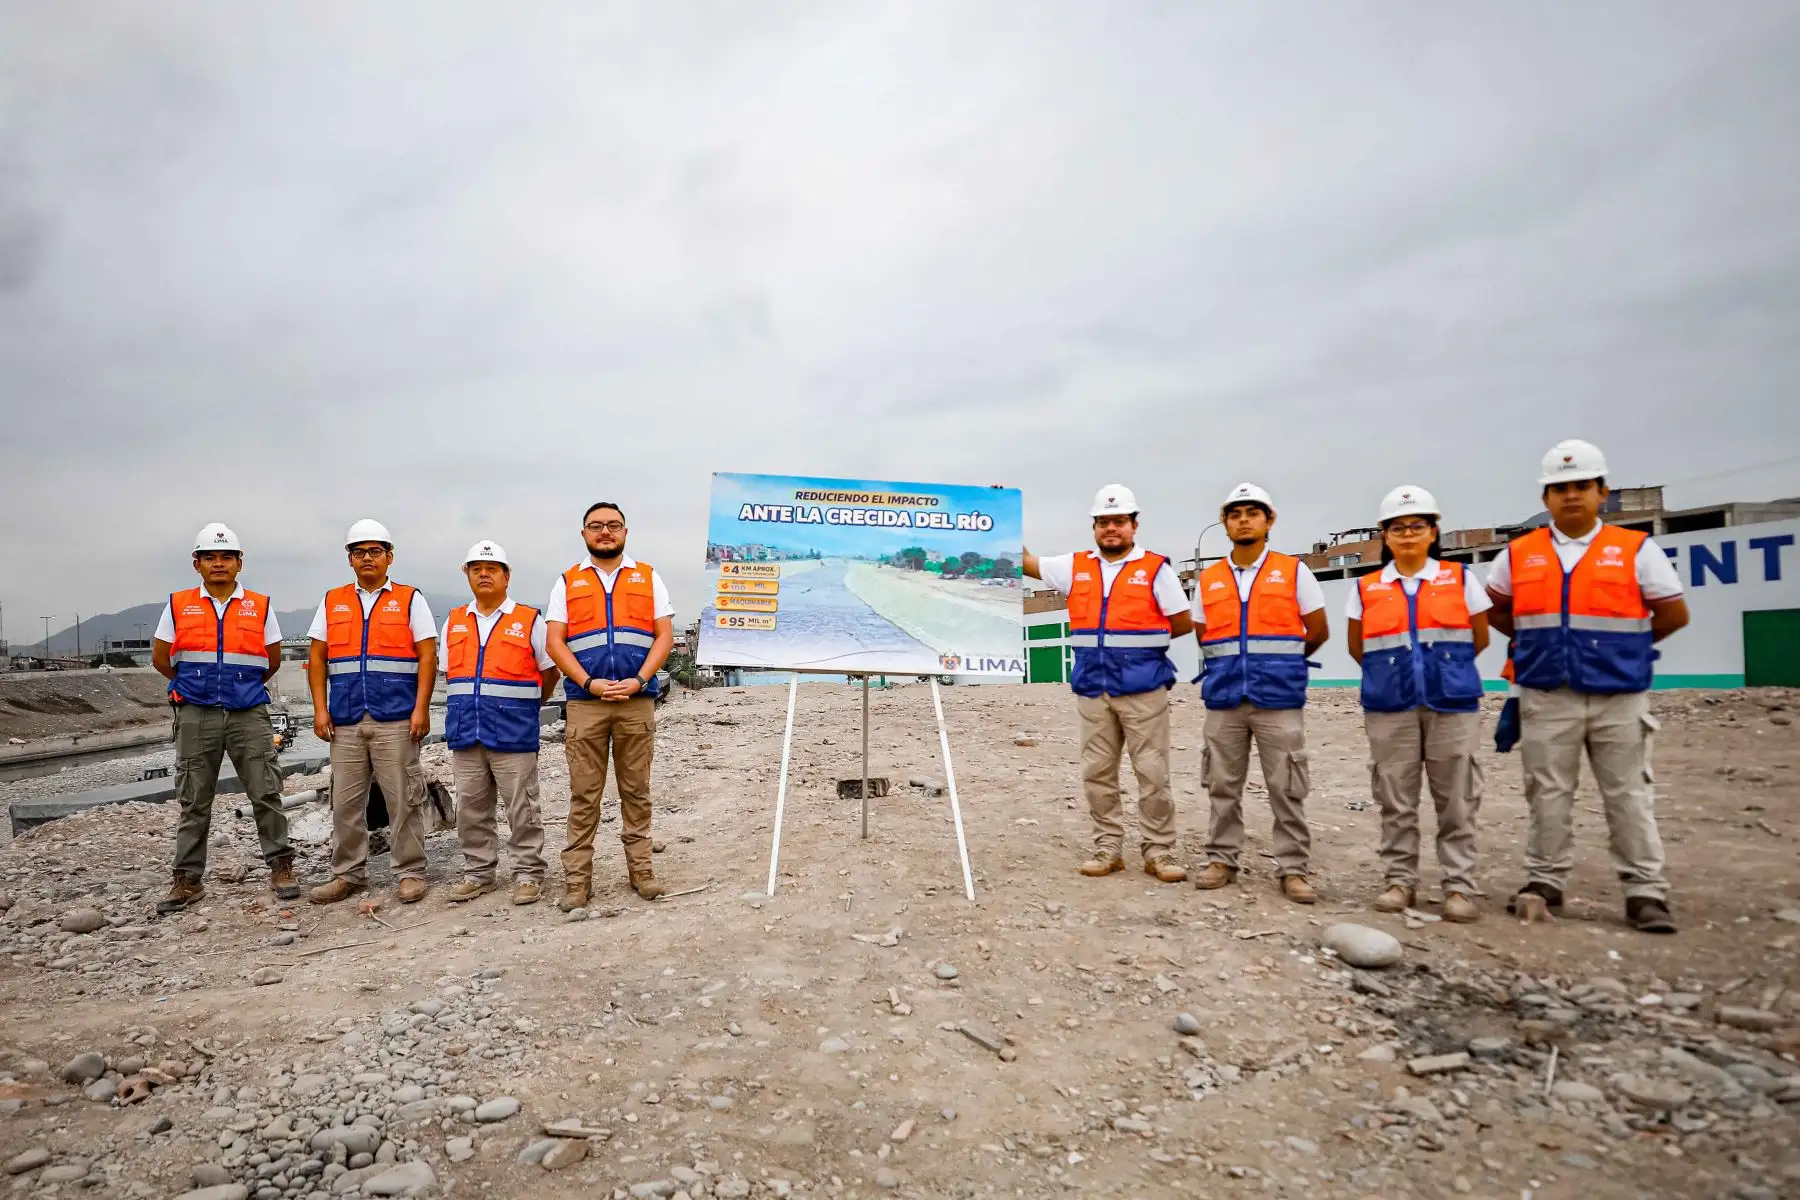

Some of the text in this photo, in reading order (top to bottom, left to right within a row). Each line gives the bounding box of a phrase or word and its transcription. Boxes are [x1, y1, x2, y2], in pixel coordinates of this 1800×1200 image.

[795, 491, 938, 506] REDUCIENDO EL IMPACTO
[738, 503, 993, 531] ANTE LA CRECIDA DEL RÍO
[731, 565, 739, 574] 4
[729, 617, 745, 627] 95
[966, 658, 1024, 672] LIMA
